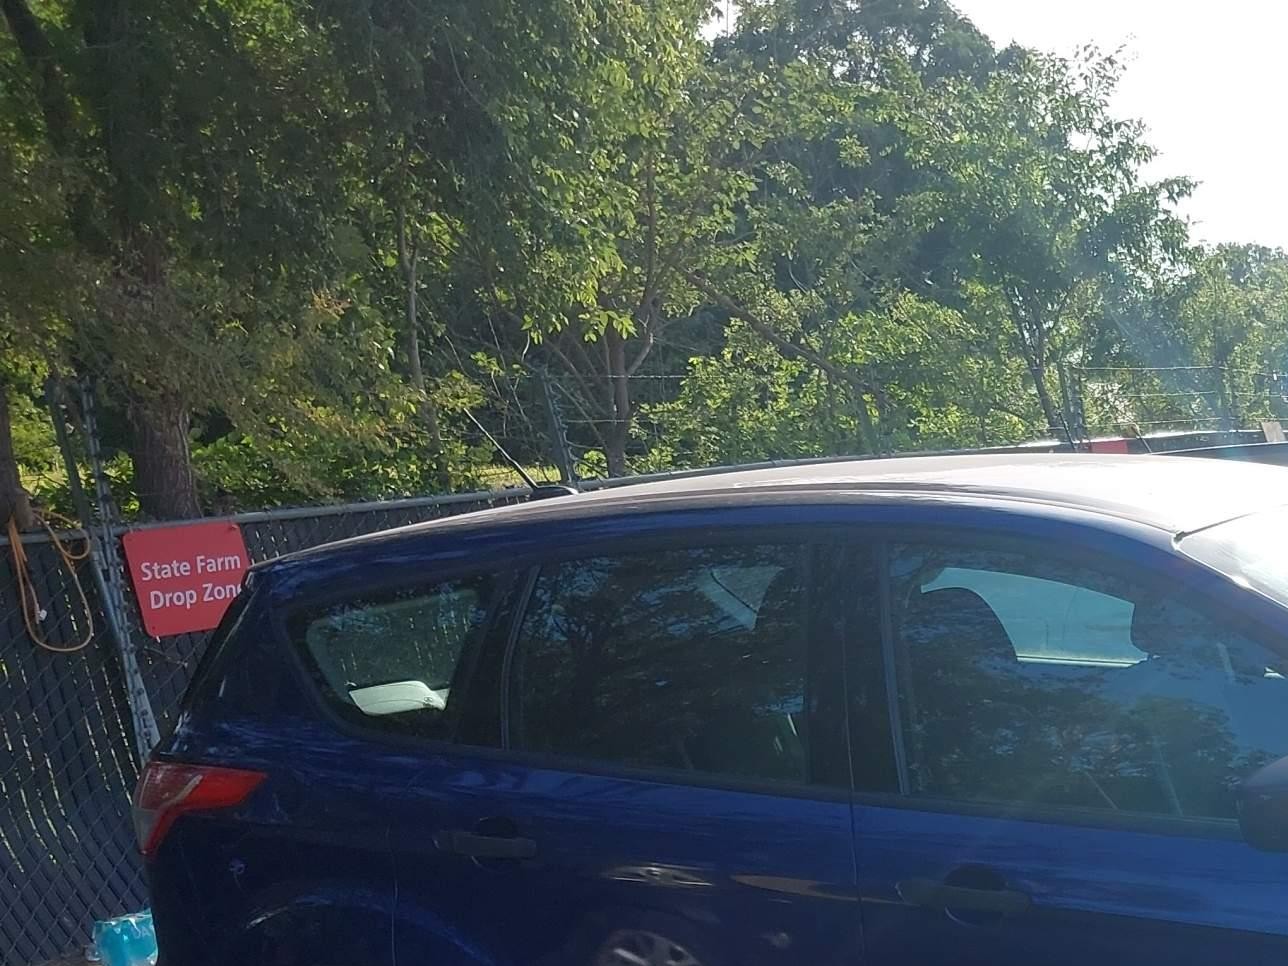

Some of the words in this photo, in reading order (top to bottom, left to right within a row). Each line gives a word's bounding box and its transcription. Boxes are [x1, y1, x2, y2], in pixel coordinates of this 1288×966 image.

[141, 560, 191, 581] State
[196, 555, 241, 574] Farm
[150, 589, 197, 609] Drop
